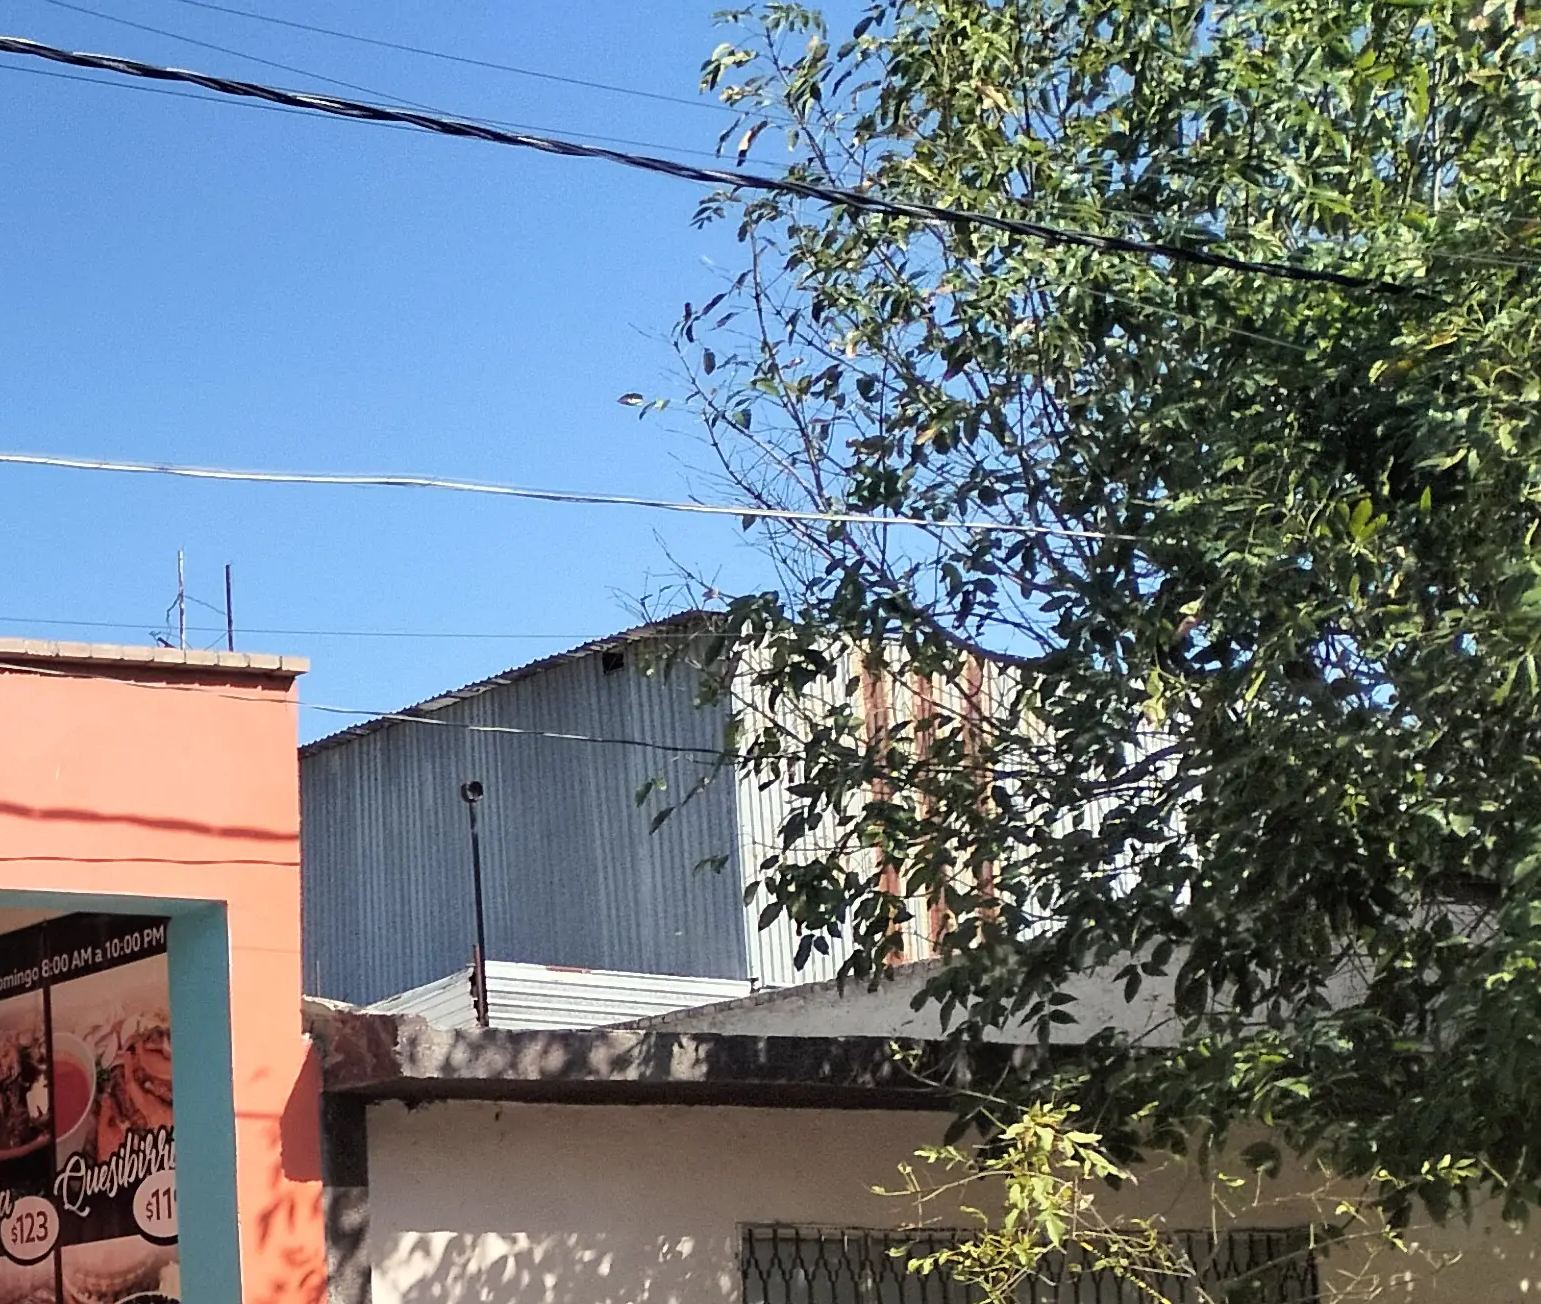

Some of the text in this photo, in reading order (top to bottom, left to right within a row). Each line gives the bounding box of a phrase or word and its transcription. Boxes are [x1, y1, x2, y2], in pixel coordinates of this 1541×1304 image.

[41, 954, 70, 978] 8:00
[70, 947, 93, 971] AM
[94, 949, 103, 962] a
[105, 932, 140, 958] 10:00
[143, 925, 166, 948] PM
[54, 1129, 176, 1217] Quesibirri
[146, 1187, 176, 1221] $11
[10, 1210, 49, 1245] $123
